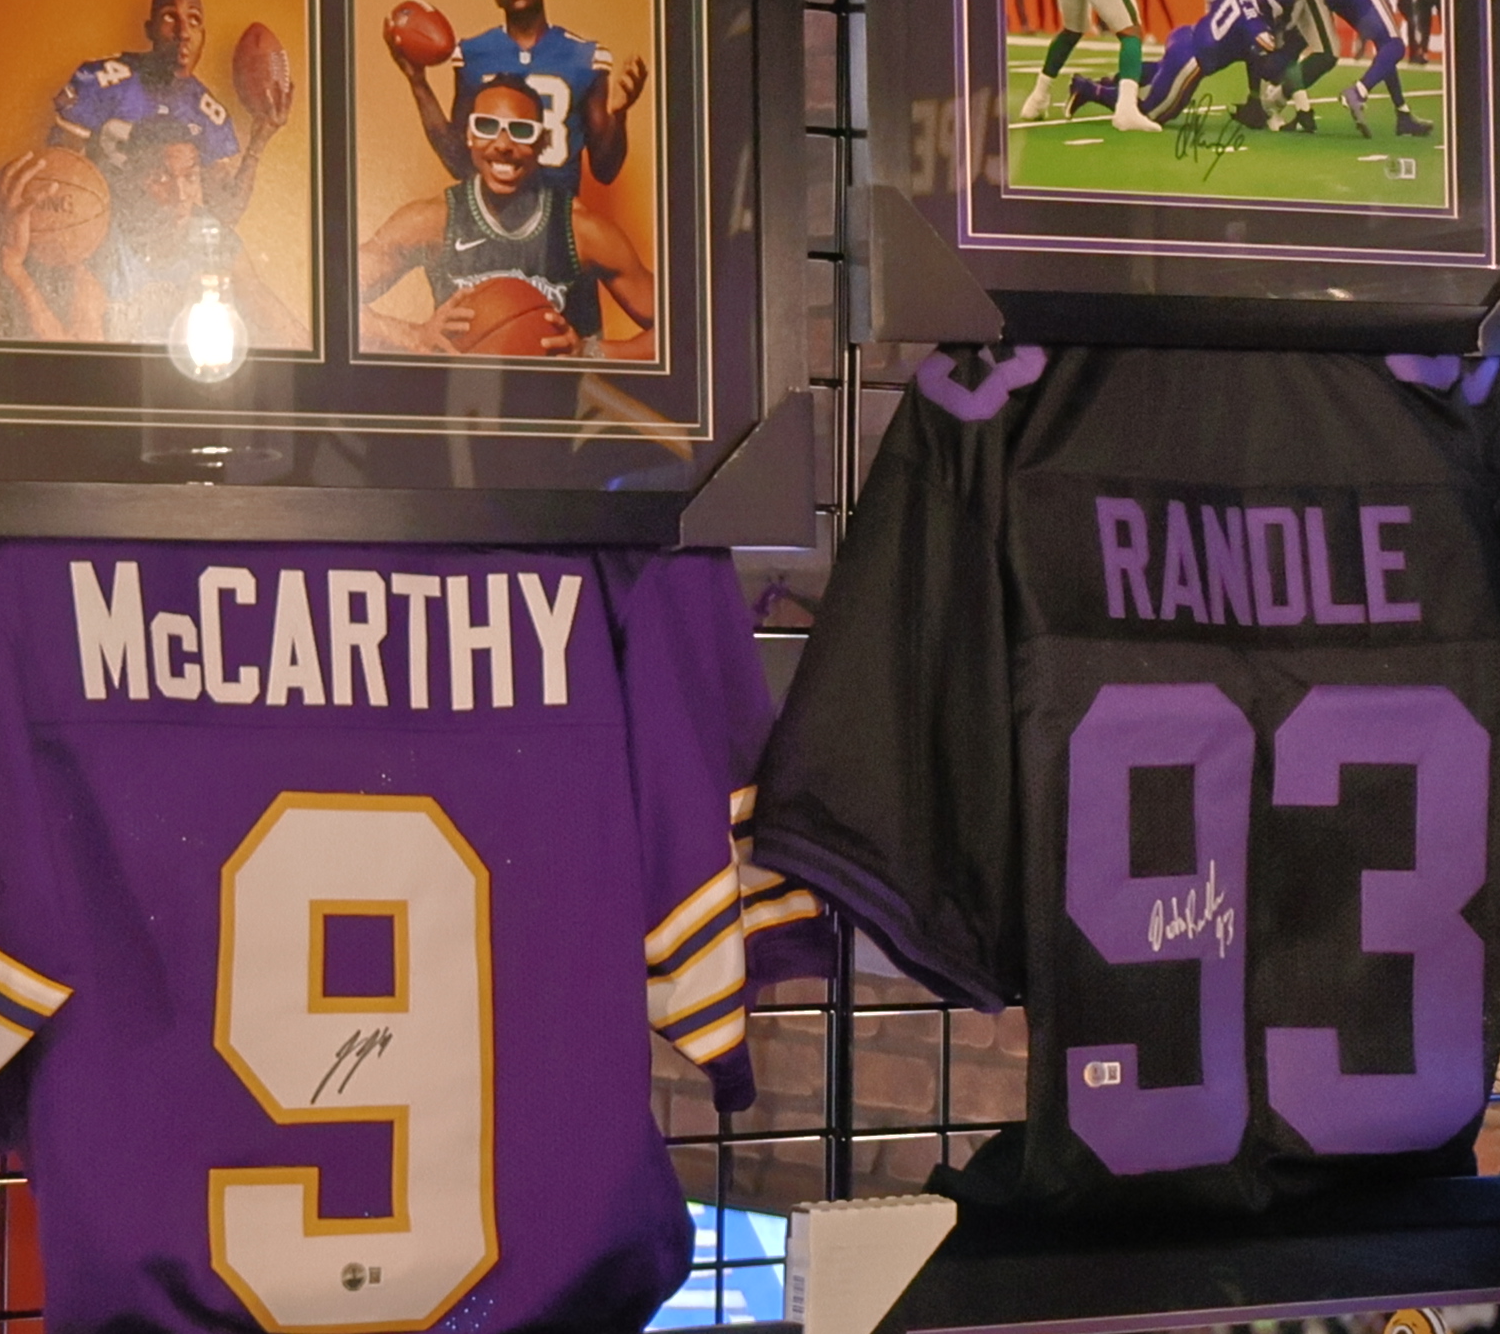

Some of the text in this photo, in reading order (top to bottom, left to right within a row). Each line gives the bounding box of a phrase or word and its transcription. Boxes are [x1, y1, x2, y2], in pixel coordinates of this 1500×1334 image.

[69, 561, 583, 711] McCARTHY
[1096, 496, 1422, 627] RANDLE
[1065, 683, 1490, 1175] 93
